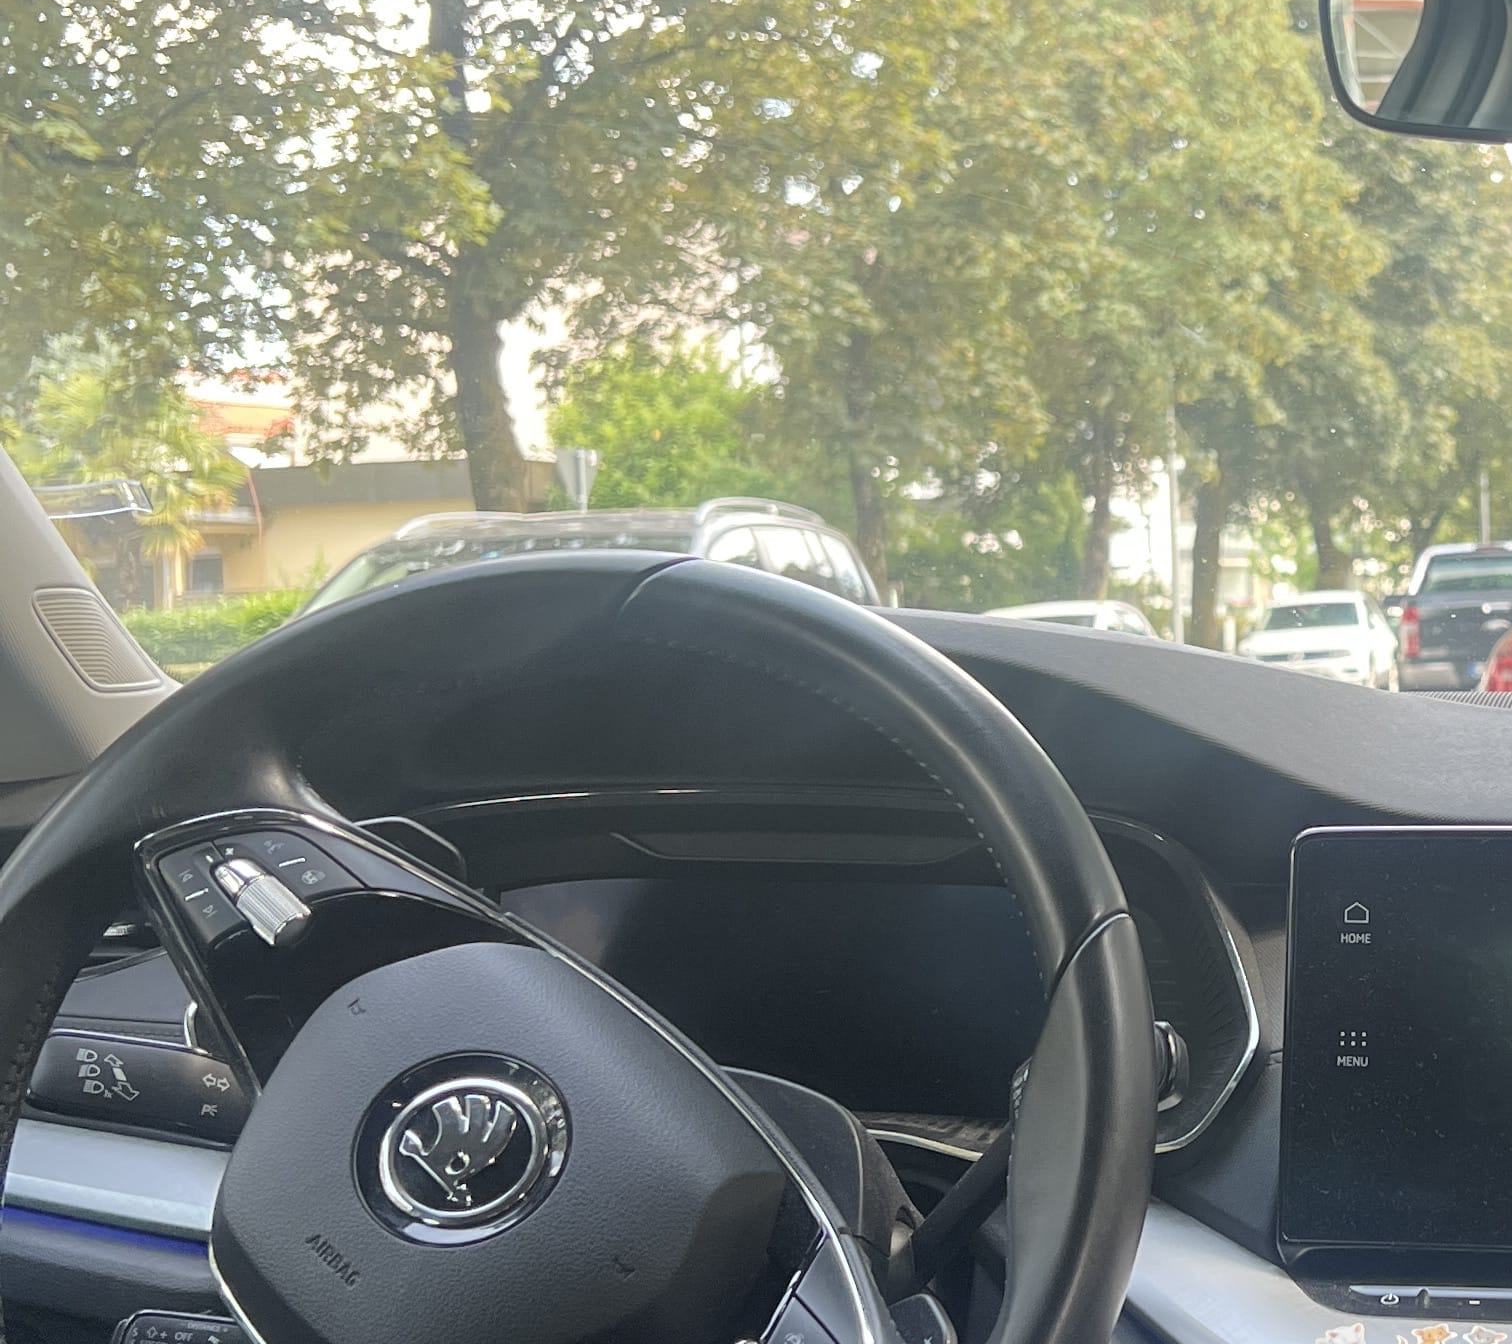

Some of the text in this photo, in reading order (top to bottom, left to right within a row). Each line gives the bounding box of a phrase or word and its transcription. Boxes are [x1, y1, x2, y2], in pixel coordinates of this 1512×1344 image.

[1340, 933, 1371, 944] HOME
[1336, 1056, 1369, 1067] MENU
[305, 1235, 360, 1287] AIRBAG
[174, 1331, 193, 1341] OFF
